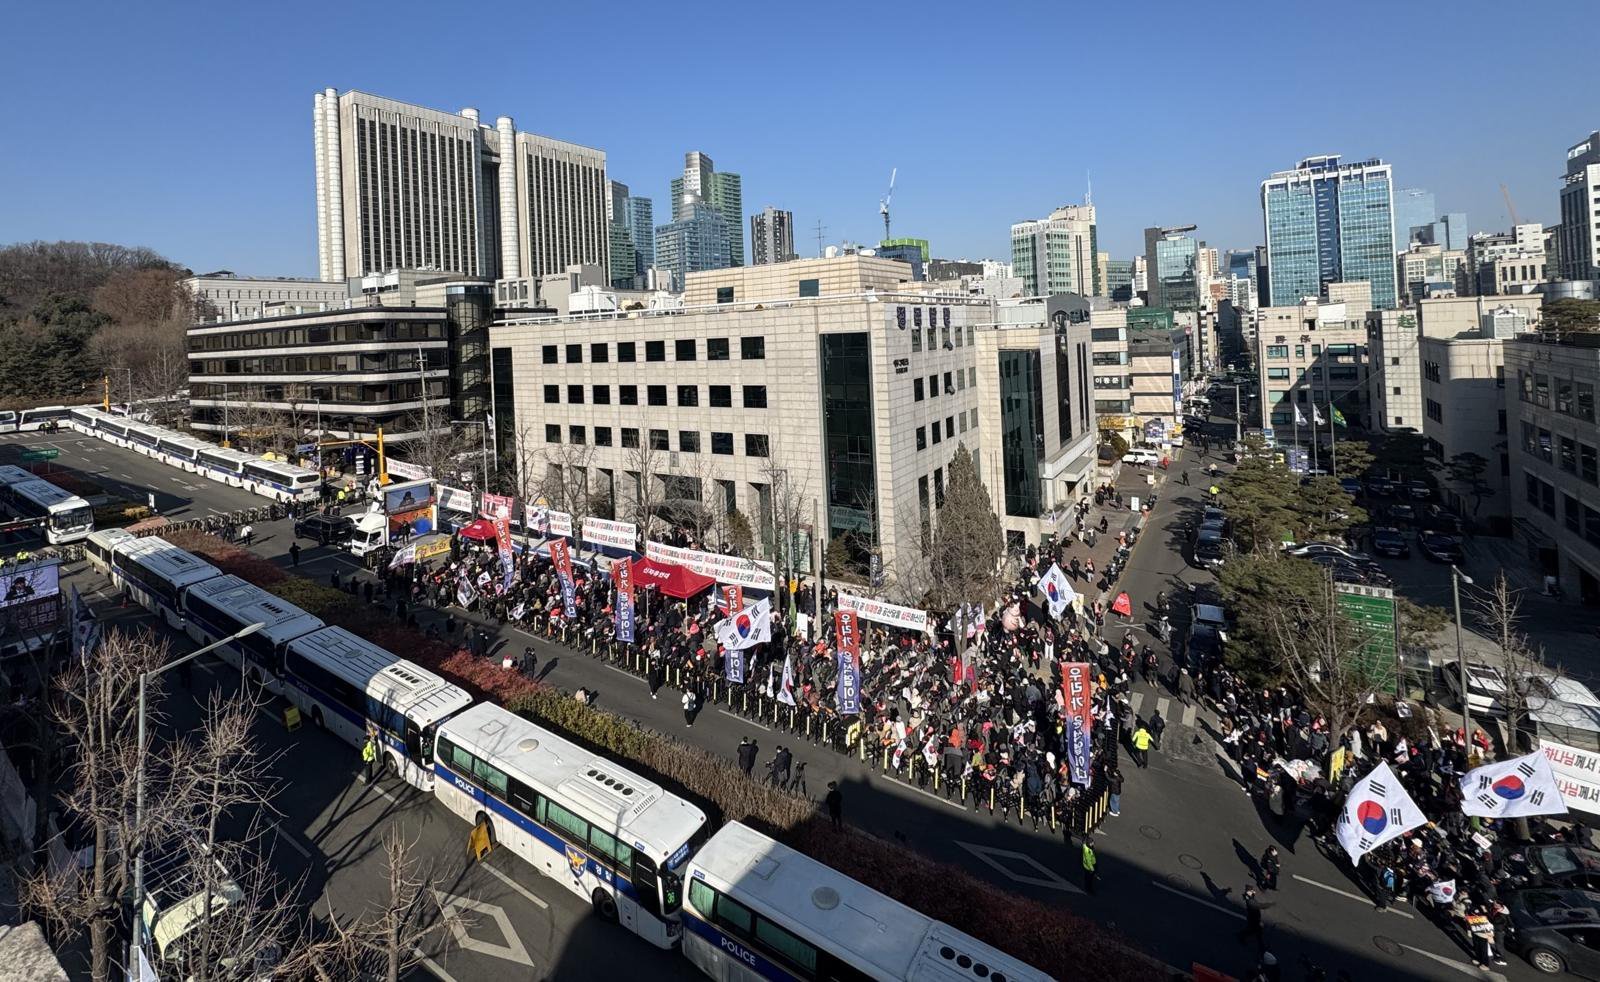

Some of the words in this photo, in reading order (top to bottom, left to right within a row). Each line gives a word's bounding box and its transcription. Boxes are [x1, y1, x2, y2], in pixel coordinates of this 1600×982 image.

[841, 614, 853, 647] 우리가
[843, 650, 854, 710] 윤석열이다
[1069, 667, 1083, 711] 우리가
[1073, 715, 1087, 779] 윤석열이다
[455, 776, 475, 795] POLICE
[1556, 778, 1600, 803] 나님께서
[720, 937, 756, 966] POLICE
